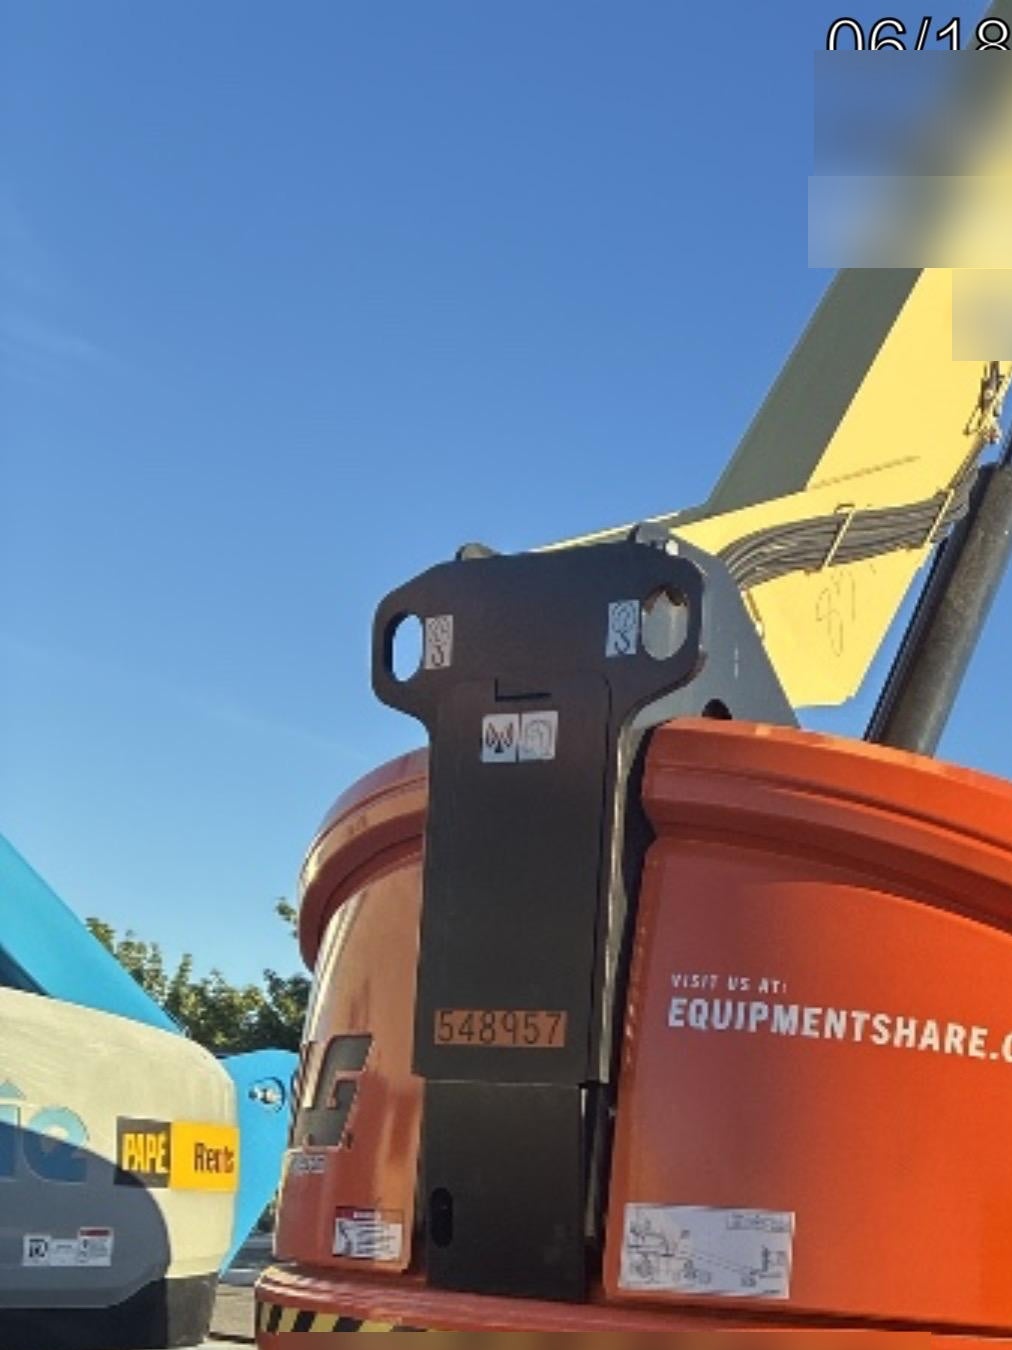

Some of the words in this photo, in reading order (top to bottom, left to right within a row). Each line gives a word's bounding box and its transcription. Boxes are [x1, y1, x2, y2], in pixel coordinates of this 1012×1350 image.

[671, 974, 719, 990] VISIT
[728, 975, 750, 992] US
[758, 977, 787, 994] AT:
[437, 1010, 562, 1046] 548957
